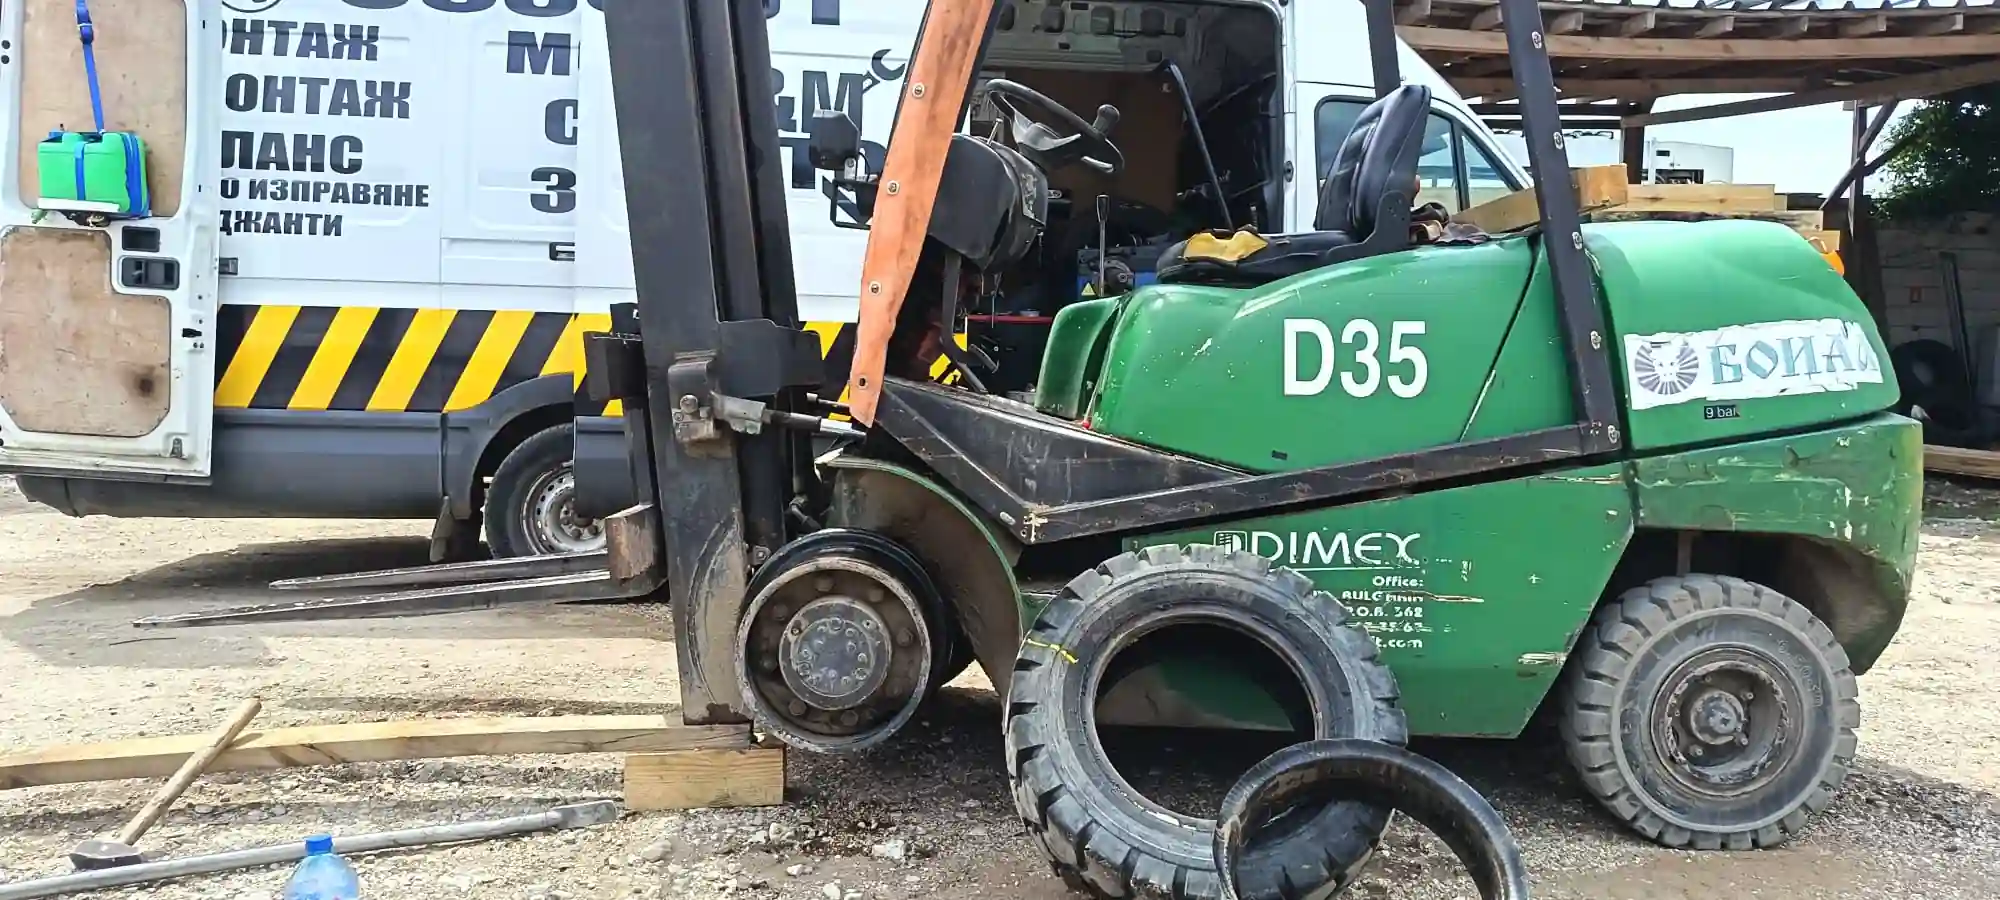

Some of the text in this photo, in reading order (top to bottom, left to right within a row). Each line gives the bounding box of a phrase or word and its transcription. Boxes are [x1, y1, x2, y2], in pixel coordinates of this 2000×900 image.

[222, 18, 380, 61] НТАЖ
[248, 179, 430, 207] ИЗПРАВЯНЕ
[219, 209, 344, 236] ДЖАНТИ
[1283, 318, 1428, 399] D35
[1706, 407, 1714, 419] 9
[1250, 531, 1421, 565] DIMEX
[1371, 575, 1424, 588] Office:
